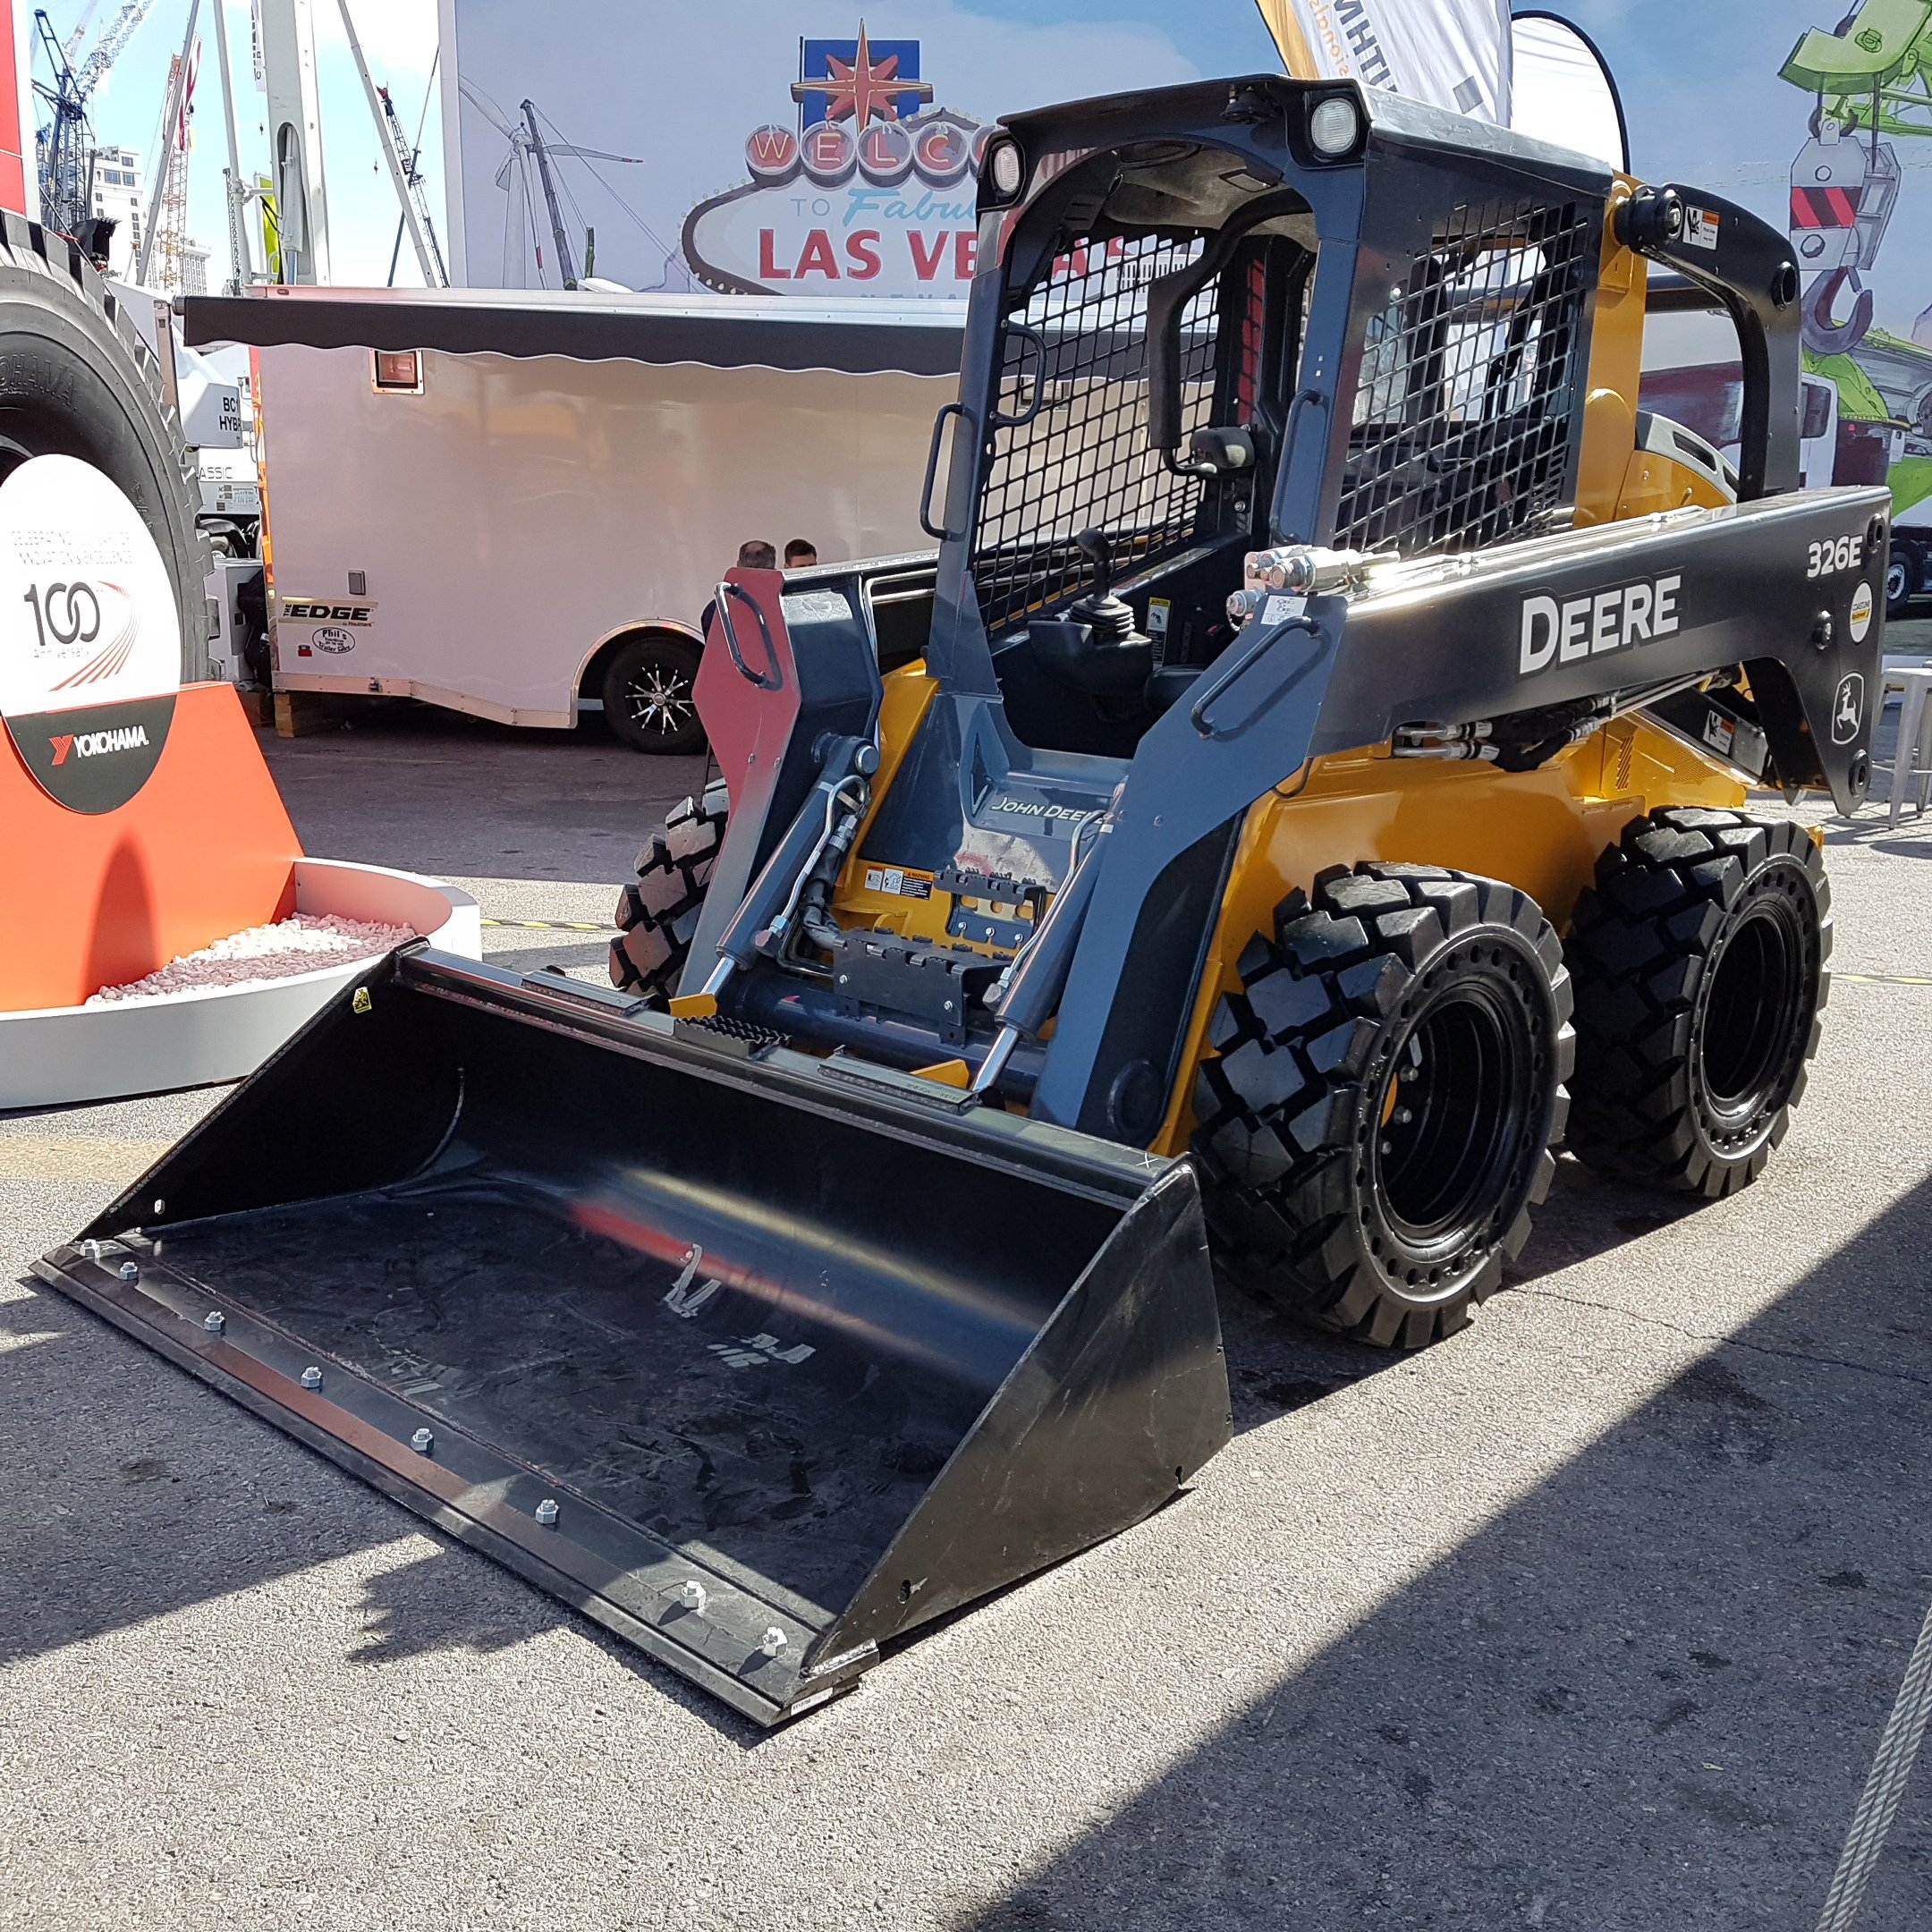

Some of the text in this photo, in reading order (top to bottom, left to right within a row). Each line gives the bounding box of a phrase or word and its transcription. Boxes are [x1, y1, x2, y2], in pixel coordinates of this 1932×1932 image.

[754, 131, 989, 164] WELC
[790, 197, 831, 217] TO
[758, 228, 883, 281] LAS
[1806, 535, 1864, 579] 326E
[23, 580, 101, 647] 100
[290, 604, 371, 622] EDGE
[1520, 574, 1682, 675] DEERE
[991, 796, 1046, 818] JOHN
